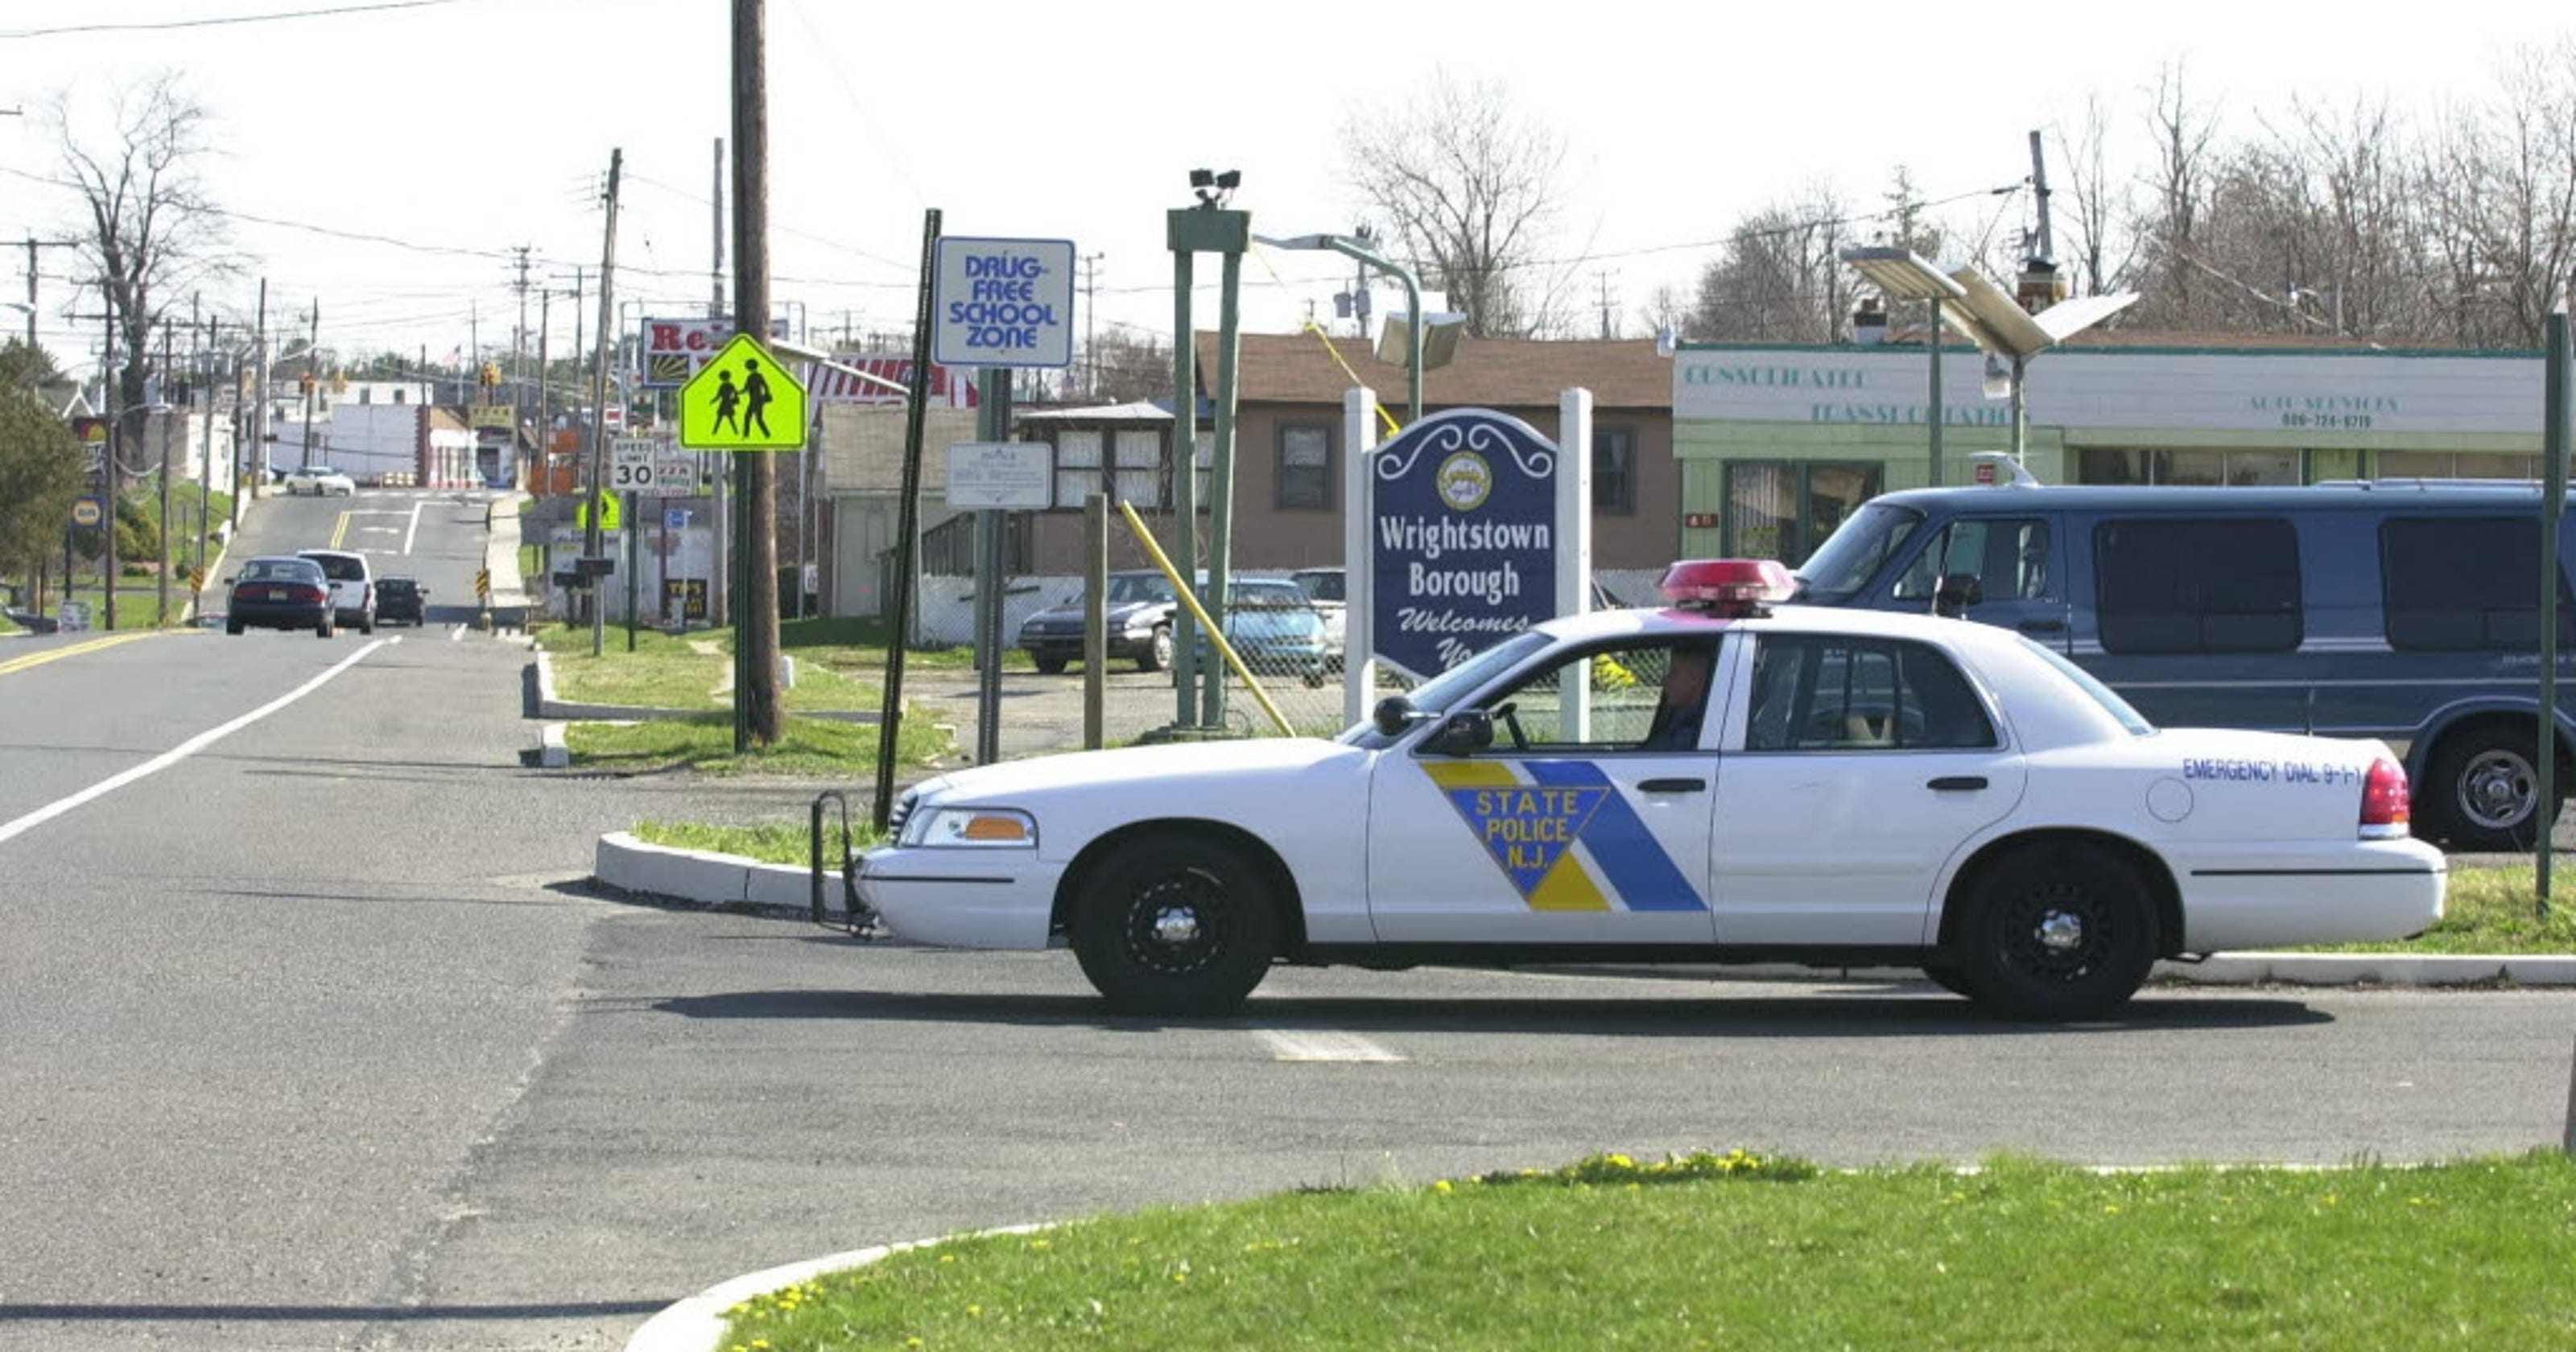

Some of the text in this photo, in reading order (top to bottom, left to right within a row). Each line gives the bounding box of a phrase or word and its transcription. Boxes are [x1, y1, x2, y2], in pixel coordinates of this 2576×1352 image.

[965, 255, 1050, 279] DRUG-
[972, 279, 1034, 302] FREE
[948, 302, 1059, 326] SCHOOL
[966, 326, 1038, 348] ZONE
[616, 442, 652, 451] SPEED
[618, 454, 648, 463] LIMIT
[616, 464, 652, 484] 30
[1380, 515, 1550, 559] Wrightstown
[1410, 560, 1520, 604] Borough
[1397, 607, 1530, 632] Welcomes
[1436, 637, 1474, 669] Yo
[2182, 758, 2277, 781] EMERGENCY
[2284, 760, 2319, 783] DIAL
[1476, 791, 1579, 815] STATE
[1486, 818, 1570, 843] POLICE
[1507, 846, 1549, 869] N.J.
